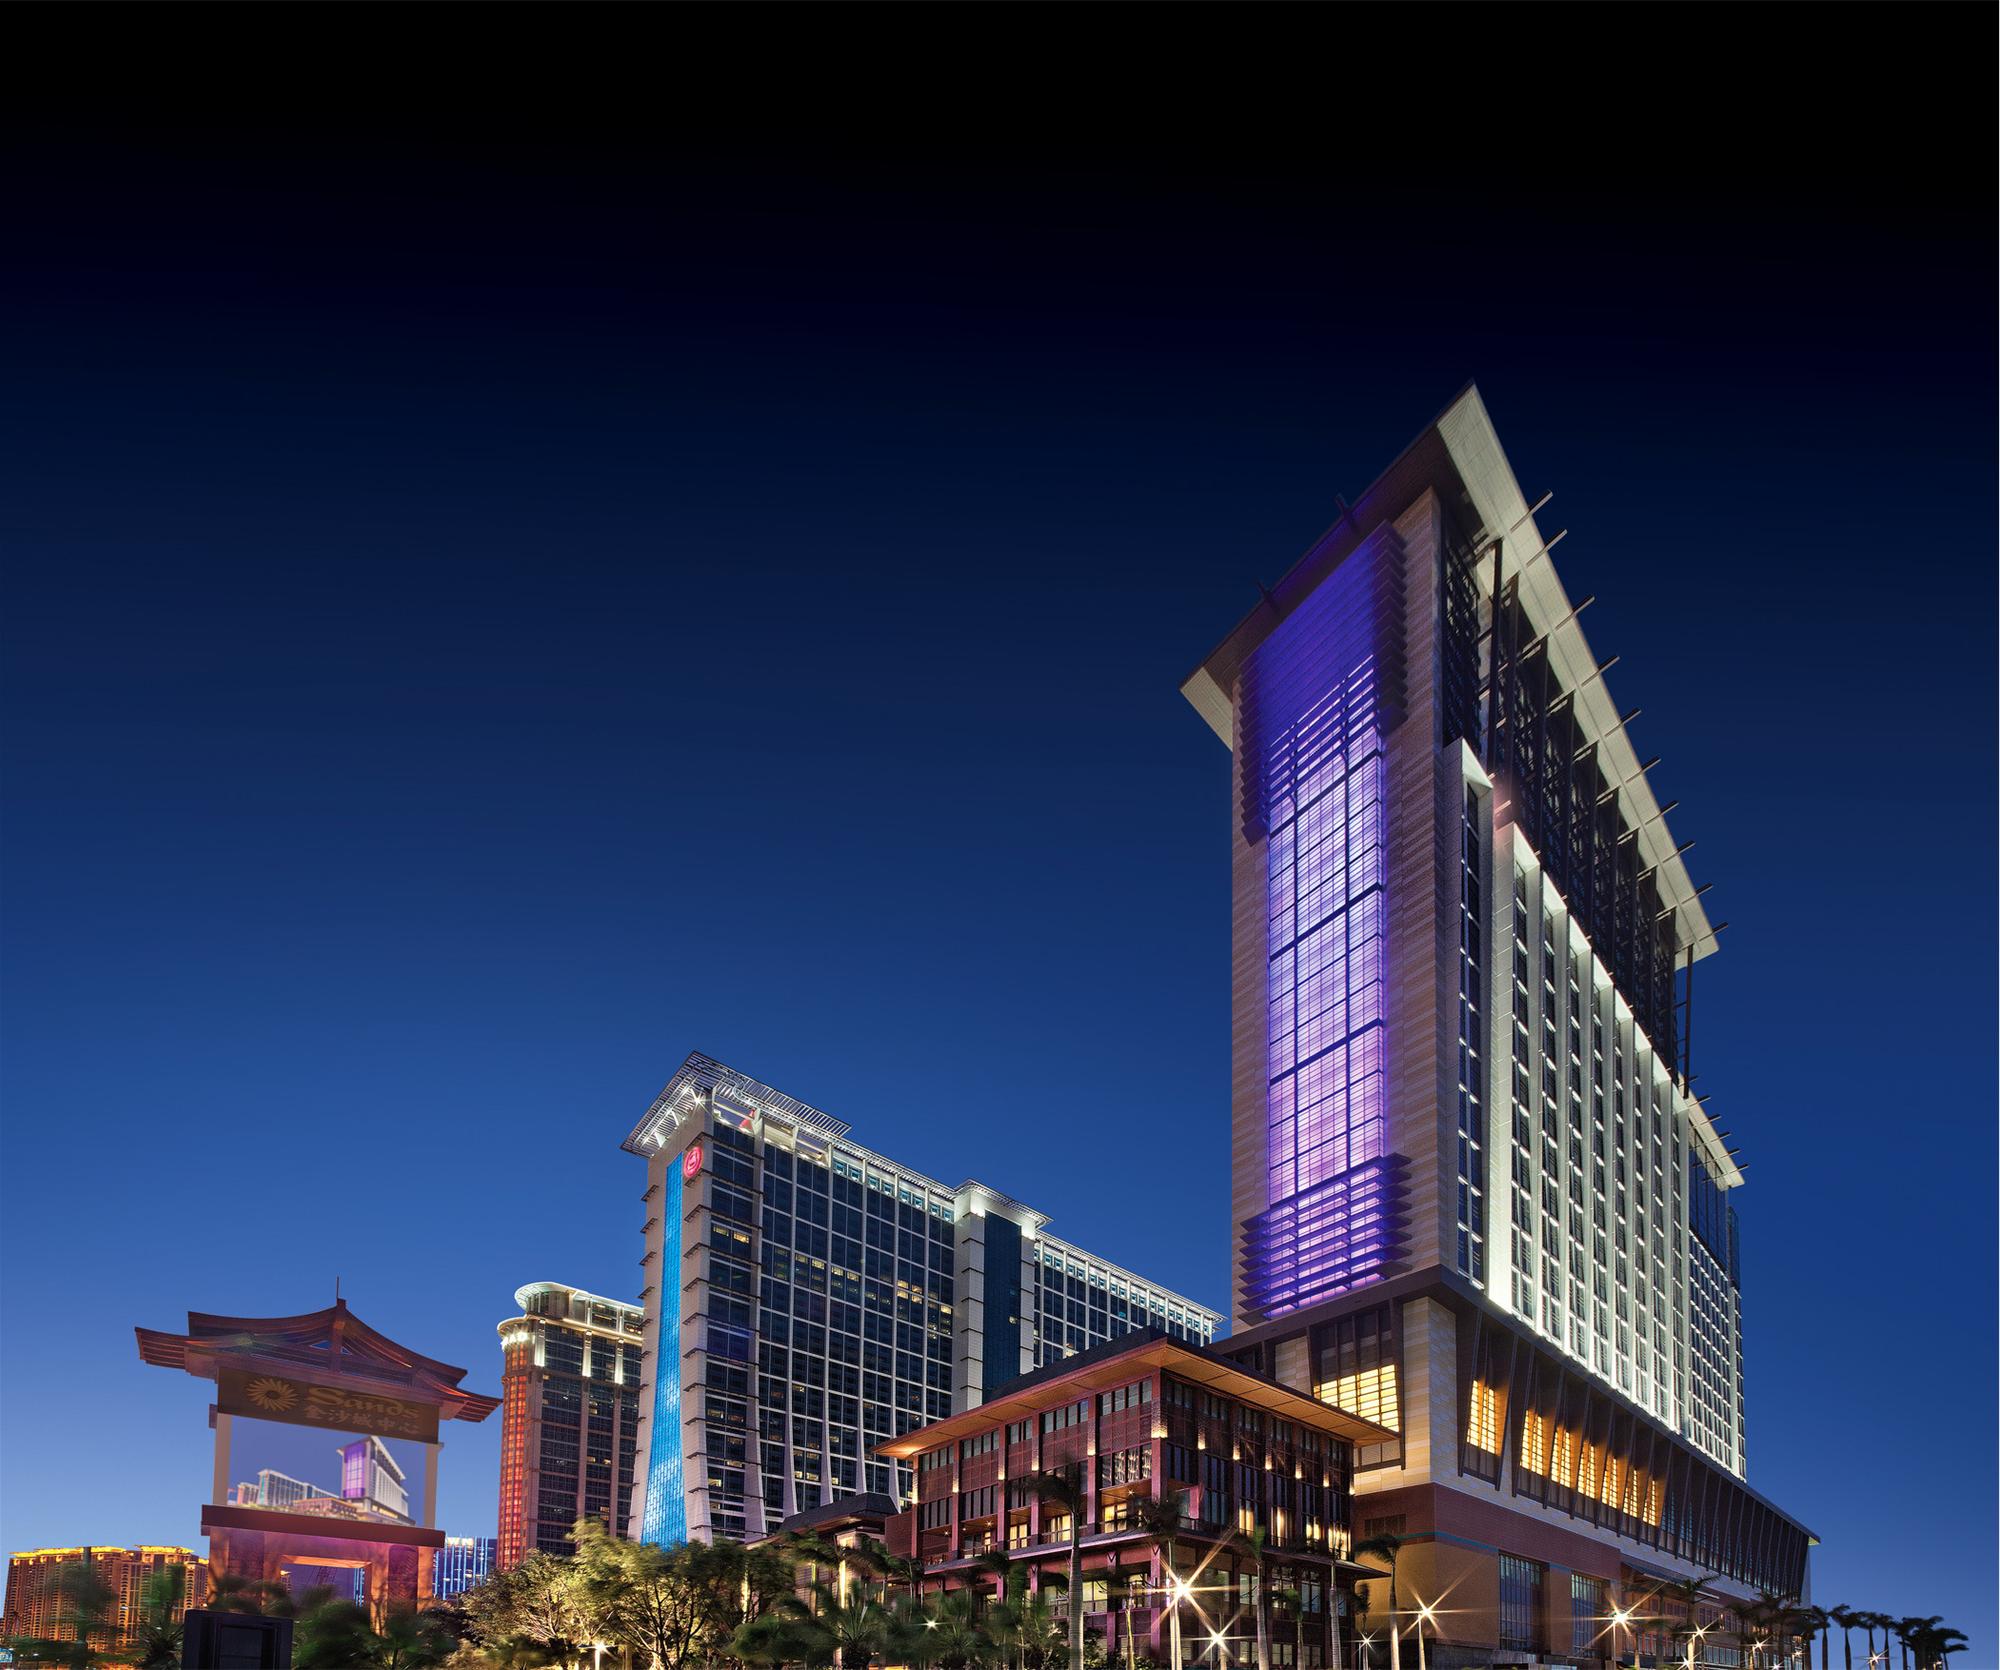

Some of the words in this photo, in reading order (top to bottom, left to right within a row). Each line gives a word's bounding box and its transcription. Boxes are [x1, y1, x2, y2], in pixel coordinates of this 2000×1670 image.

[306, 1387, 419, 1418] Sands
[304, 1405, 420, 1434] 金沙城中心
